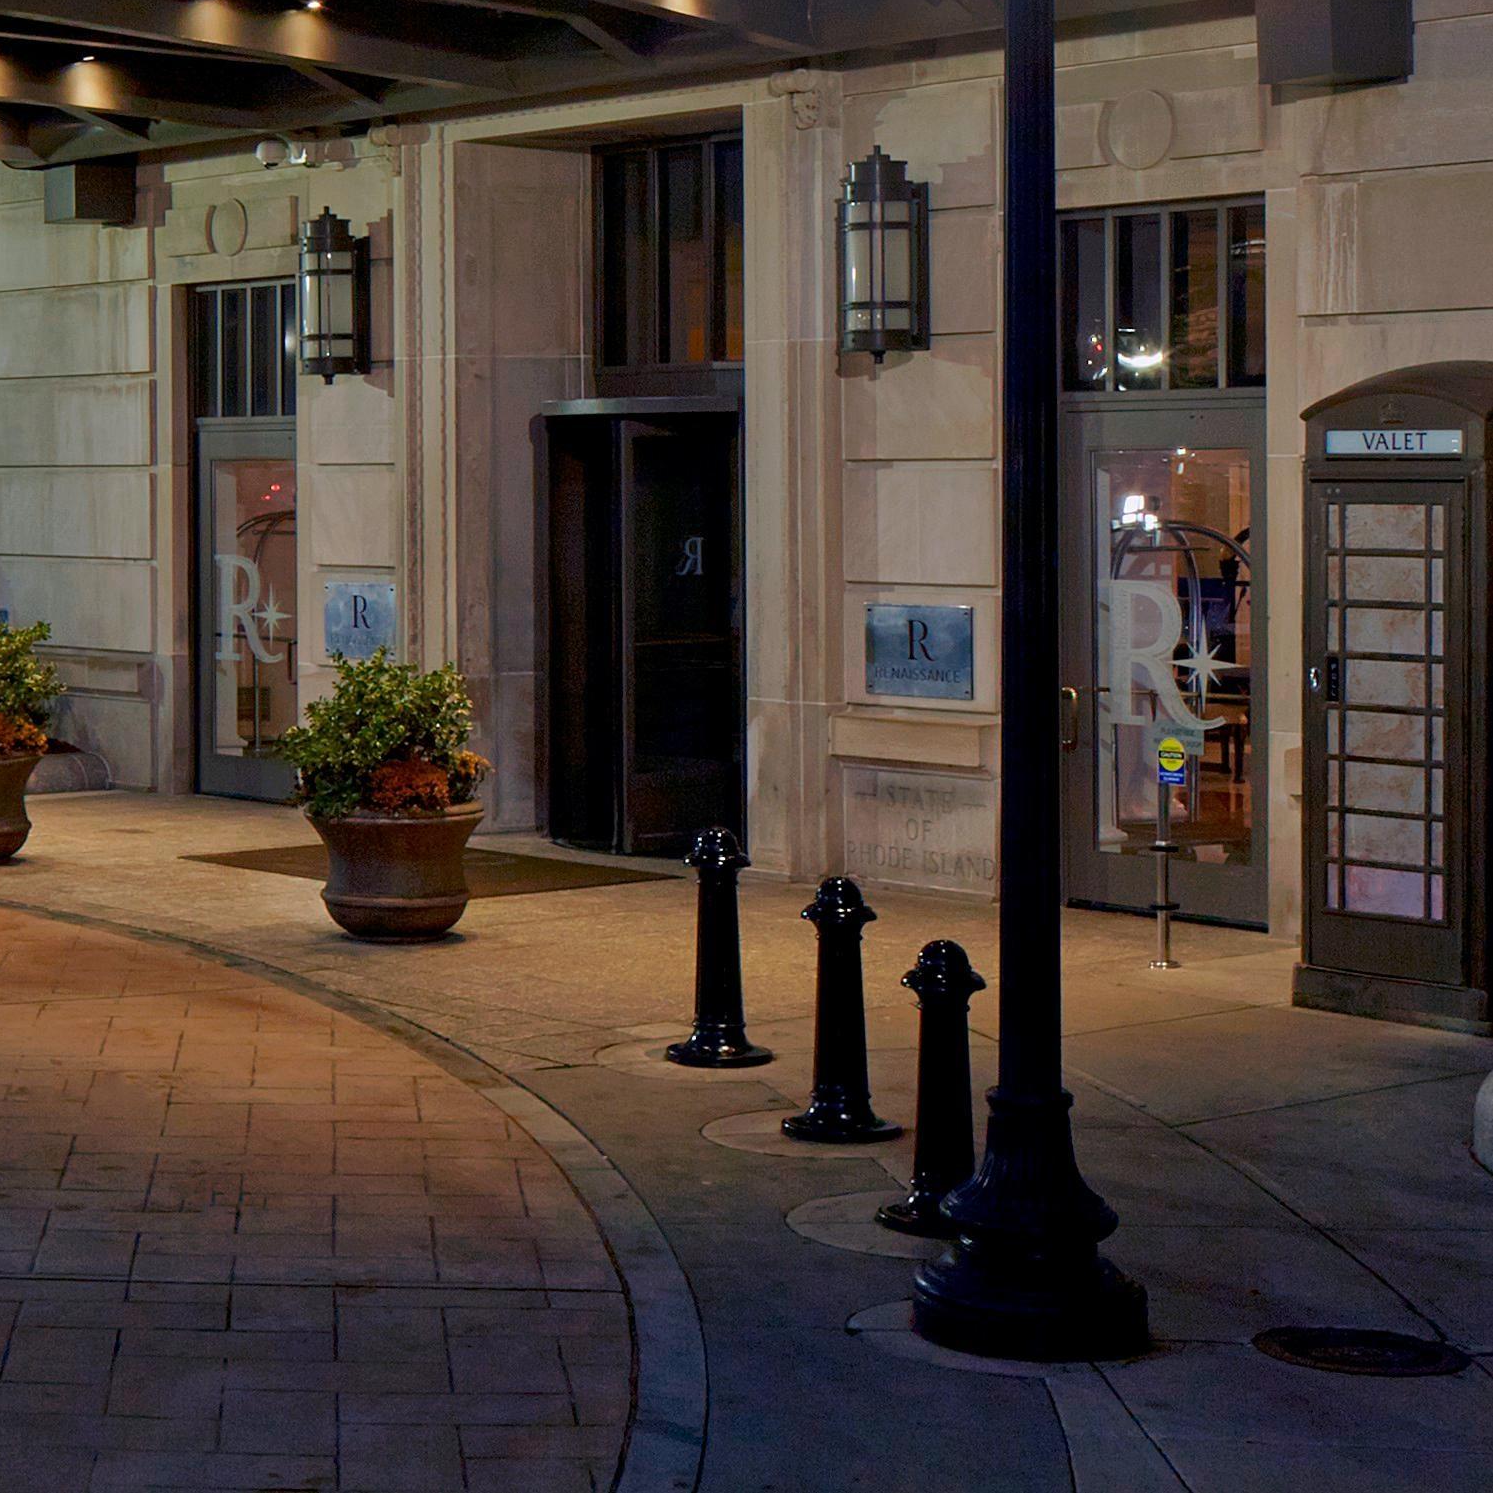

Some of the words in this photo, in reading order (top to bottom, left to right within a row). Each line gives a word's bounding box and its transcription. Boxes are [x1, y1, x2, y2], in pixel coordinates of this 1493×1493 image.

[1362, 432, 1427, 451] VALET
[213, 553, 285, 664] R
[351, 594, 371, 629] R
[907, 619, 937, 662] R
[1106, 579, 1227, 730] R
[875, 667, 961, 684] RENAISSANCE
[886, 784, 957, 816] STATE
[905, 818, 933, 842] OF
[922, 850, 996, 881] ISLAND
